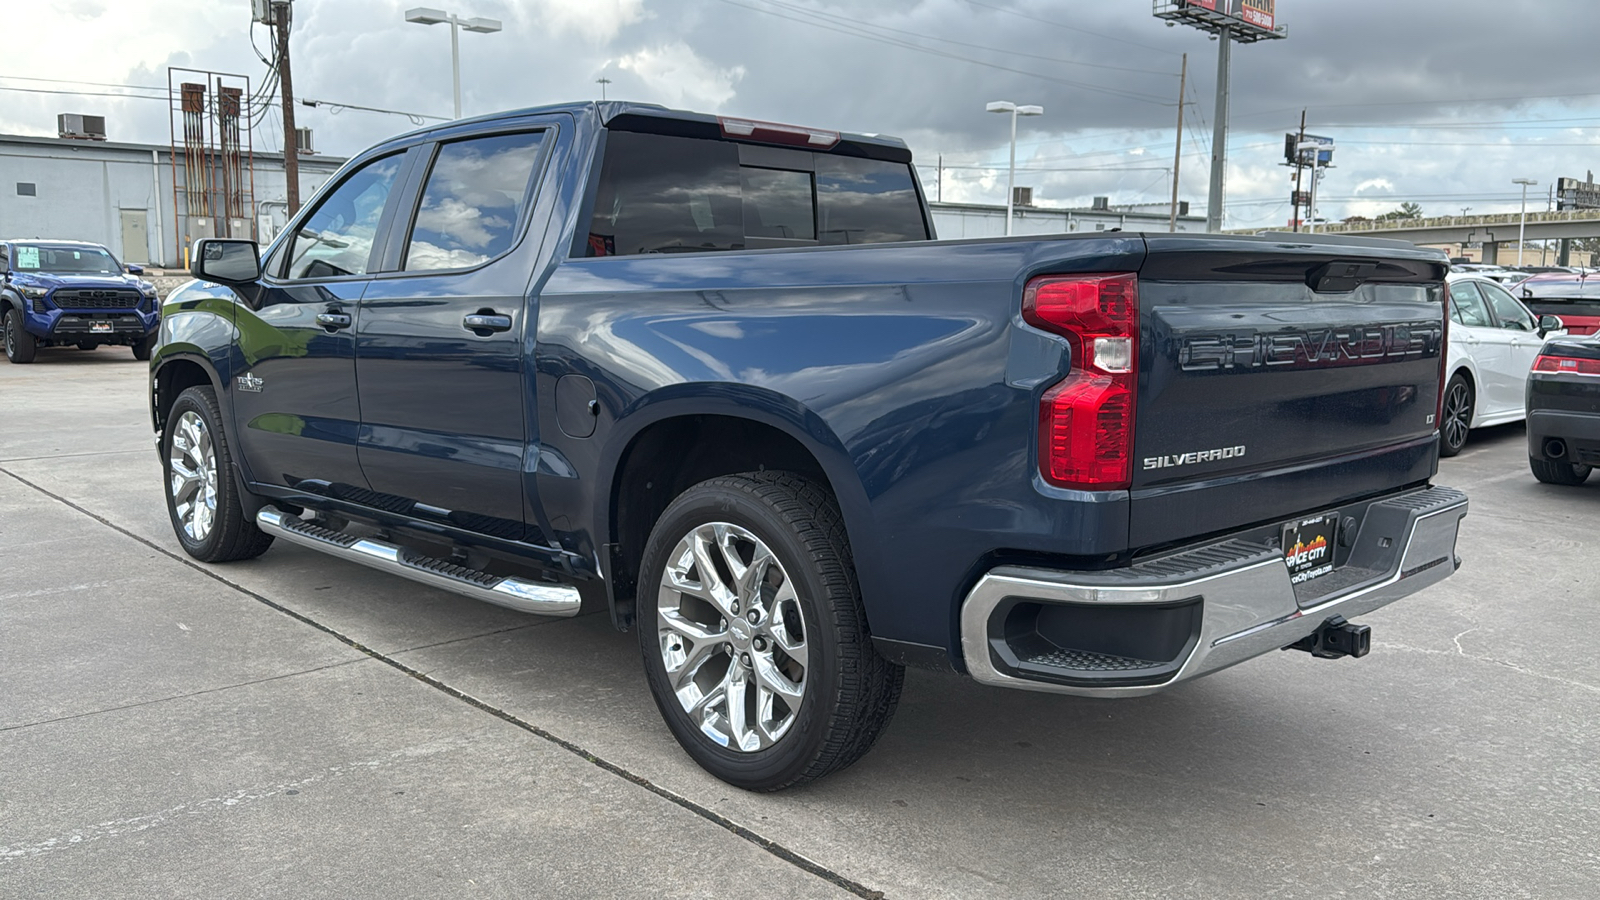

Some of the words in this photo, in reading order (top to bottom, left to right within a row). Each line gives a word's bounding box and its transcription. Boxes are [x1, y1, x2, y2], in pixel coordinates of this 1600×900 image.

[1179, 321, 1441, 371] CHEVROLET
[1426, 414, 1435, 424] LT
[1143, 445, 1246, 470] SILVERADO
[1308, 546, 1326, 560] CITY
